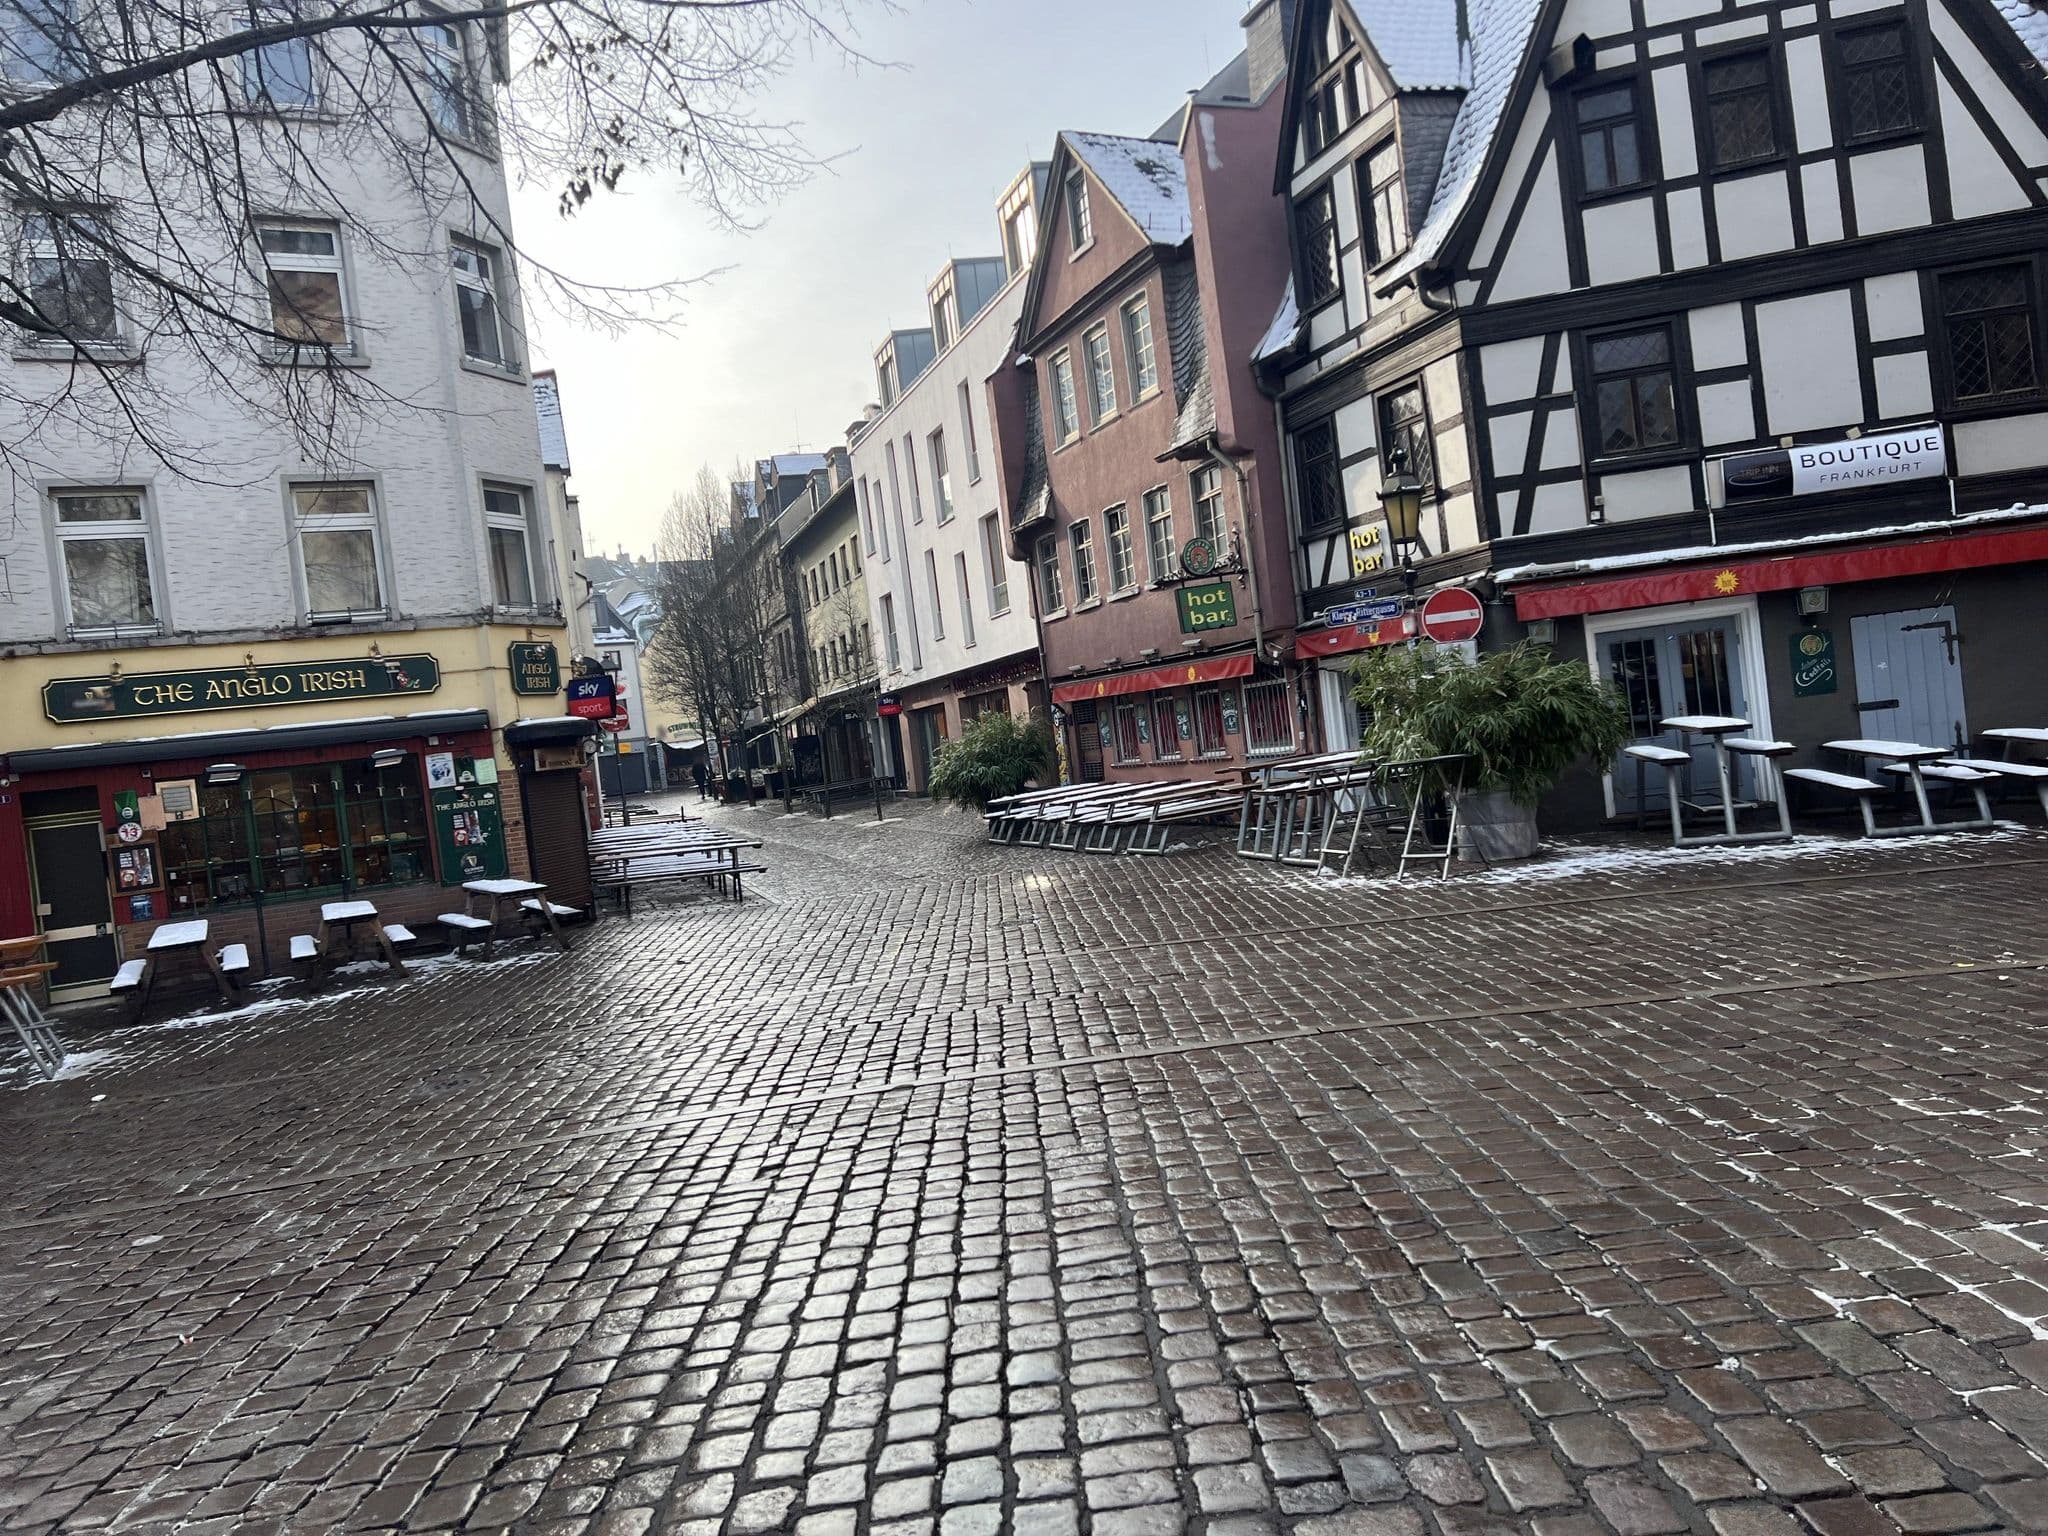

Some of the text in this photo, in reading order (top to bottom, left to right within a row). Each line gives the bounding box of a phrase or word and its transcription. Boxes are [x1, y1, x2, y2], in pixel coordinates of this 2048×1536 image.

[1800, 436, 1940, 469] BOUTIQUE
[1819, 461, 1922, 484] FRANKFURT
[1350, 526, 1380, 549] hot
[1353, 553, 1384, 574] bar
[1187, 589, 1227, 607] hot
[1190, 609, 1229, 625] bar
[522, 662, 552, 675] ANGLO
[132, 669, 367, 706] THE ANGLO IRISH
[526, 676, 552, 689] IRISH
[578, 682, 599, 697] sky
[577, 702, 603, 715] sport
[435, 802, 451, 812] THE
